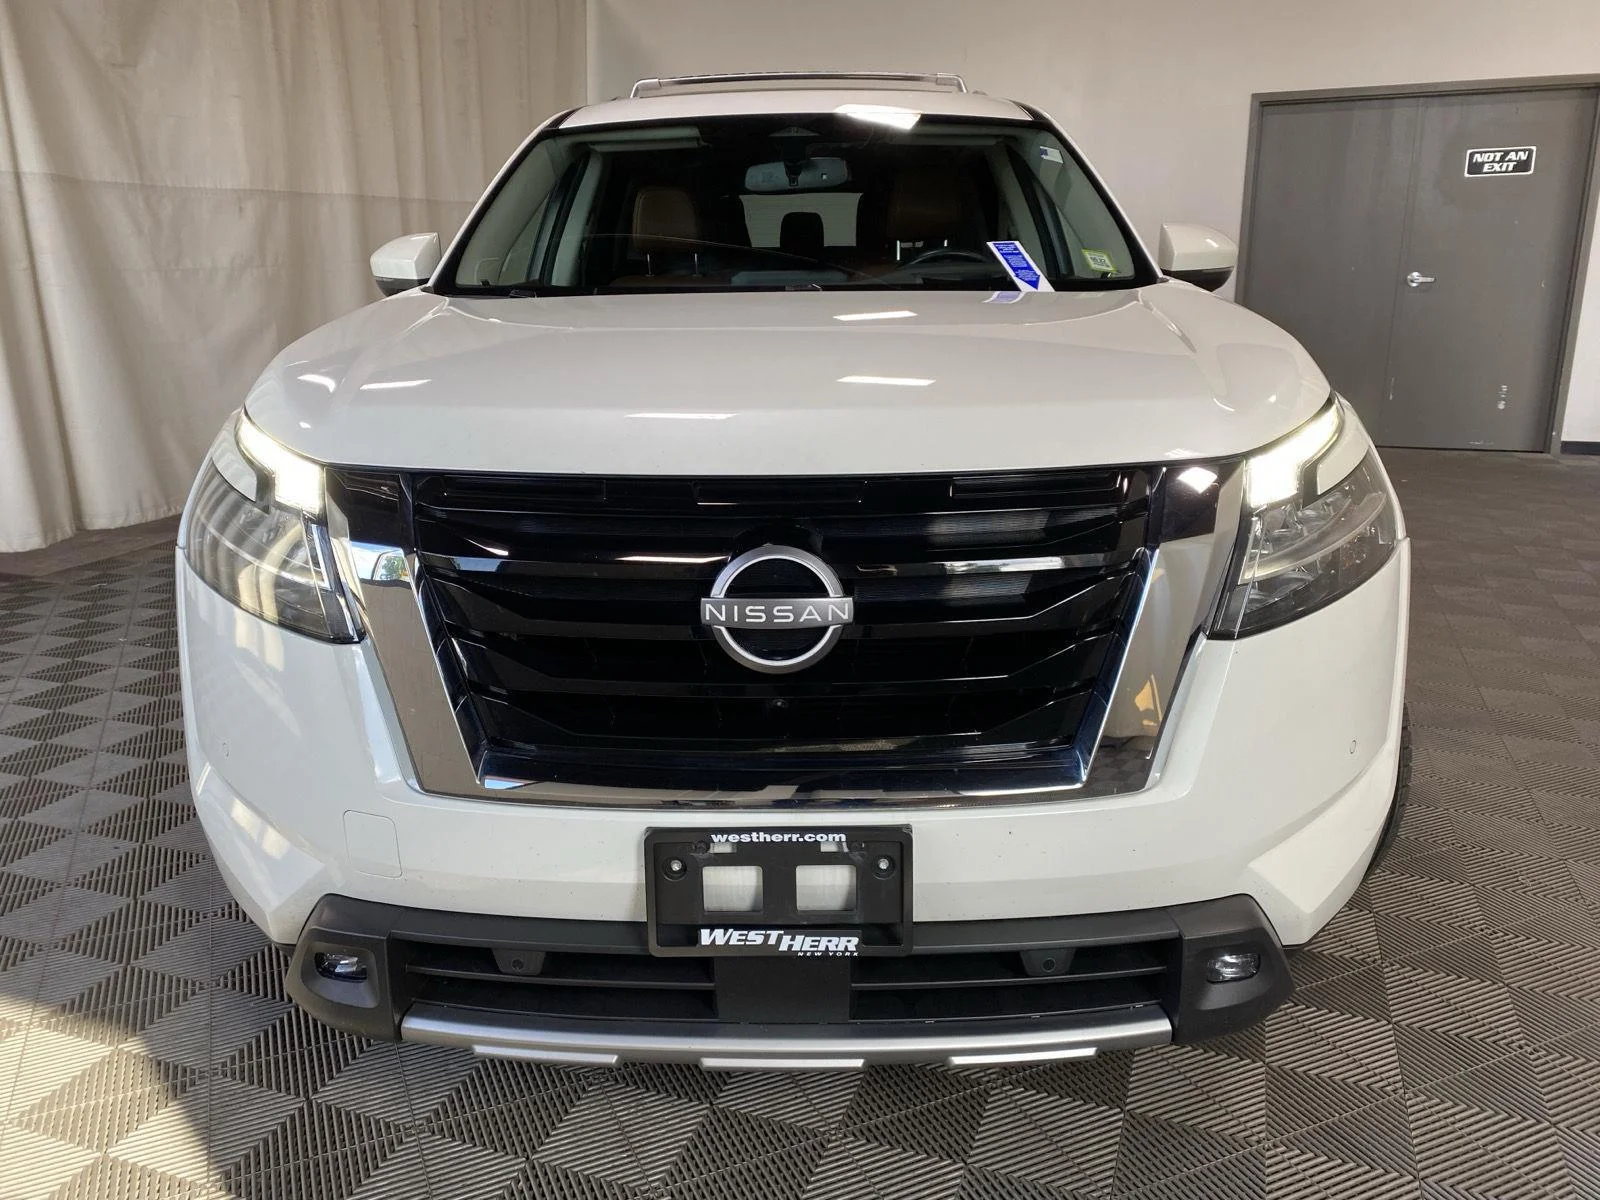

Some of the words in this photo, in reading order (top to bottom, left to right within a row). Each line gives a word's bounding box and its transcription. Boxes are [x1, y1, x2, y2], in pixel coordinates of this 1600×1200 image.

[1472, 152, 1504, 163] NOT
[1504, 151, 1529, 161] AN
[1482, 161, 1517, 173] EXIT
[705, 603, 849, 623] NISSAN
[710, 832, 847, 843] westherr.com
